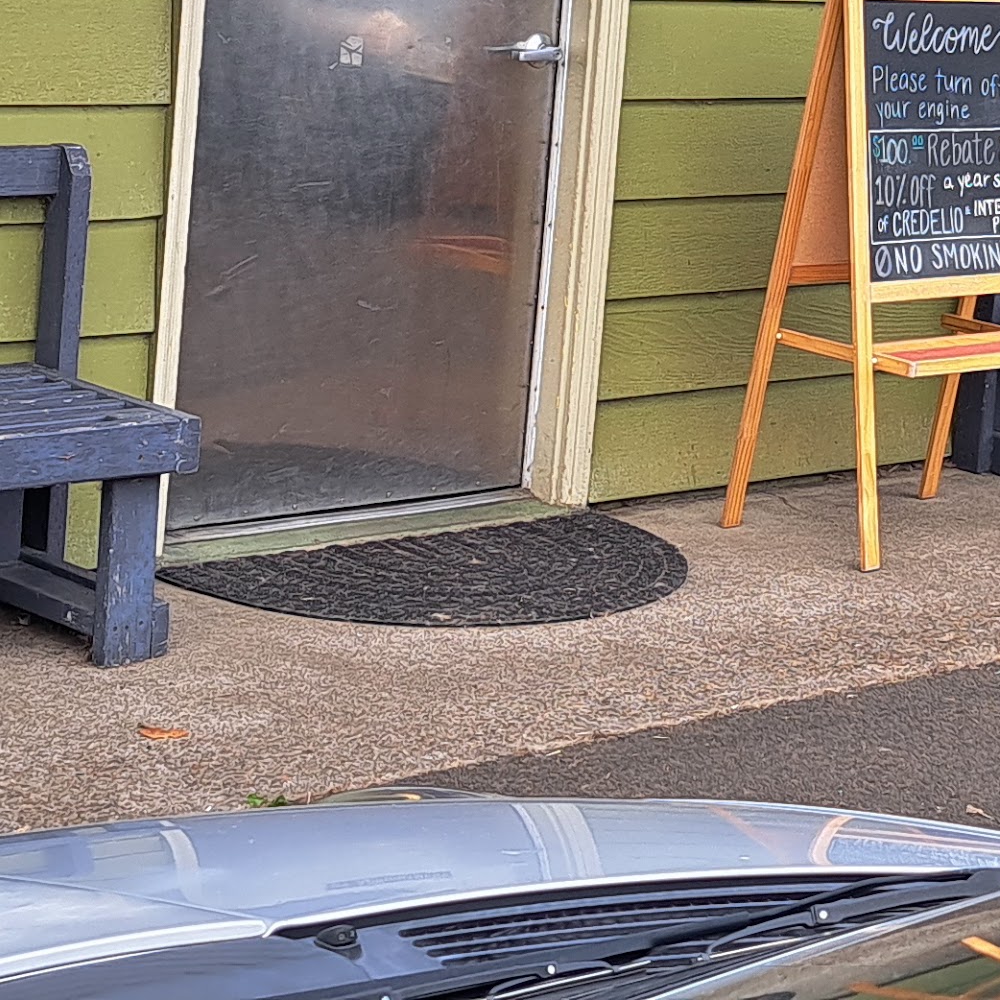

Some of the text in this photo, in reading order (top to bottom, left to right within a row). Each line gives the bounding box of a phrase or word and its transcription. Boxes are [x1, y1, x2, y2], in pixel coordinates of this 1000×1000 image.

[872, 65, 927, 94] Please
[935, 68, 972, 95] turn
[875, 99, 970, 128] your engine
[927, 132, 996, 167] Rebate
[943, 177, 954, 190] a
[957, 172, 991, 197] year
[877, 215, 889, 233] of
[892, 205, 964, 237] CREDELIO
[894, 244, 923, 276] NO
